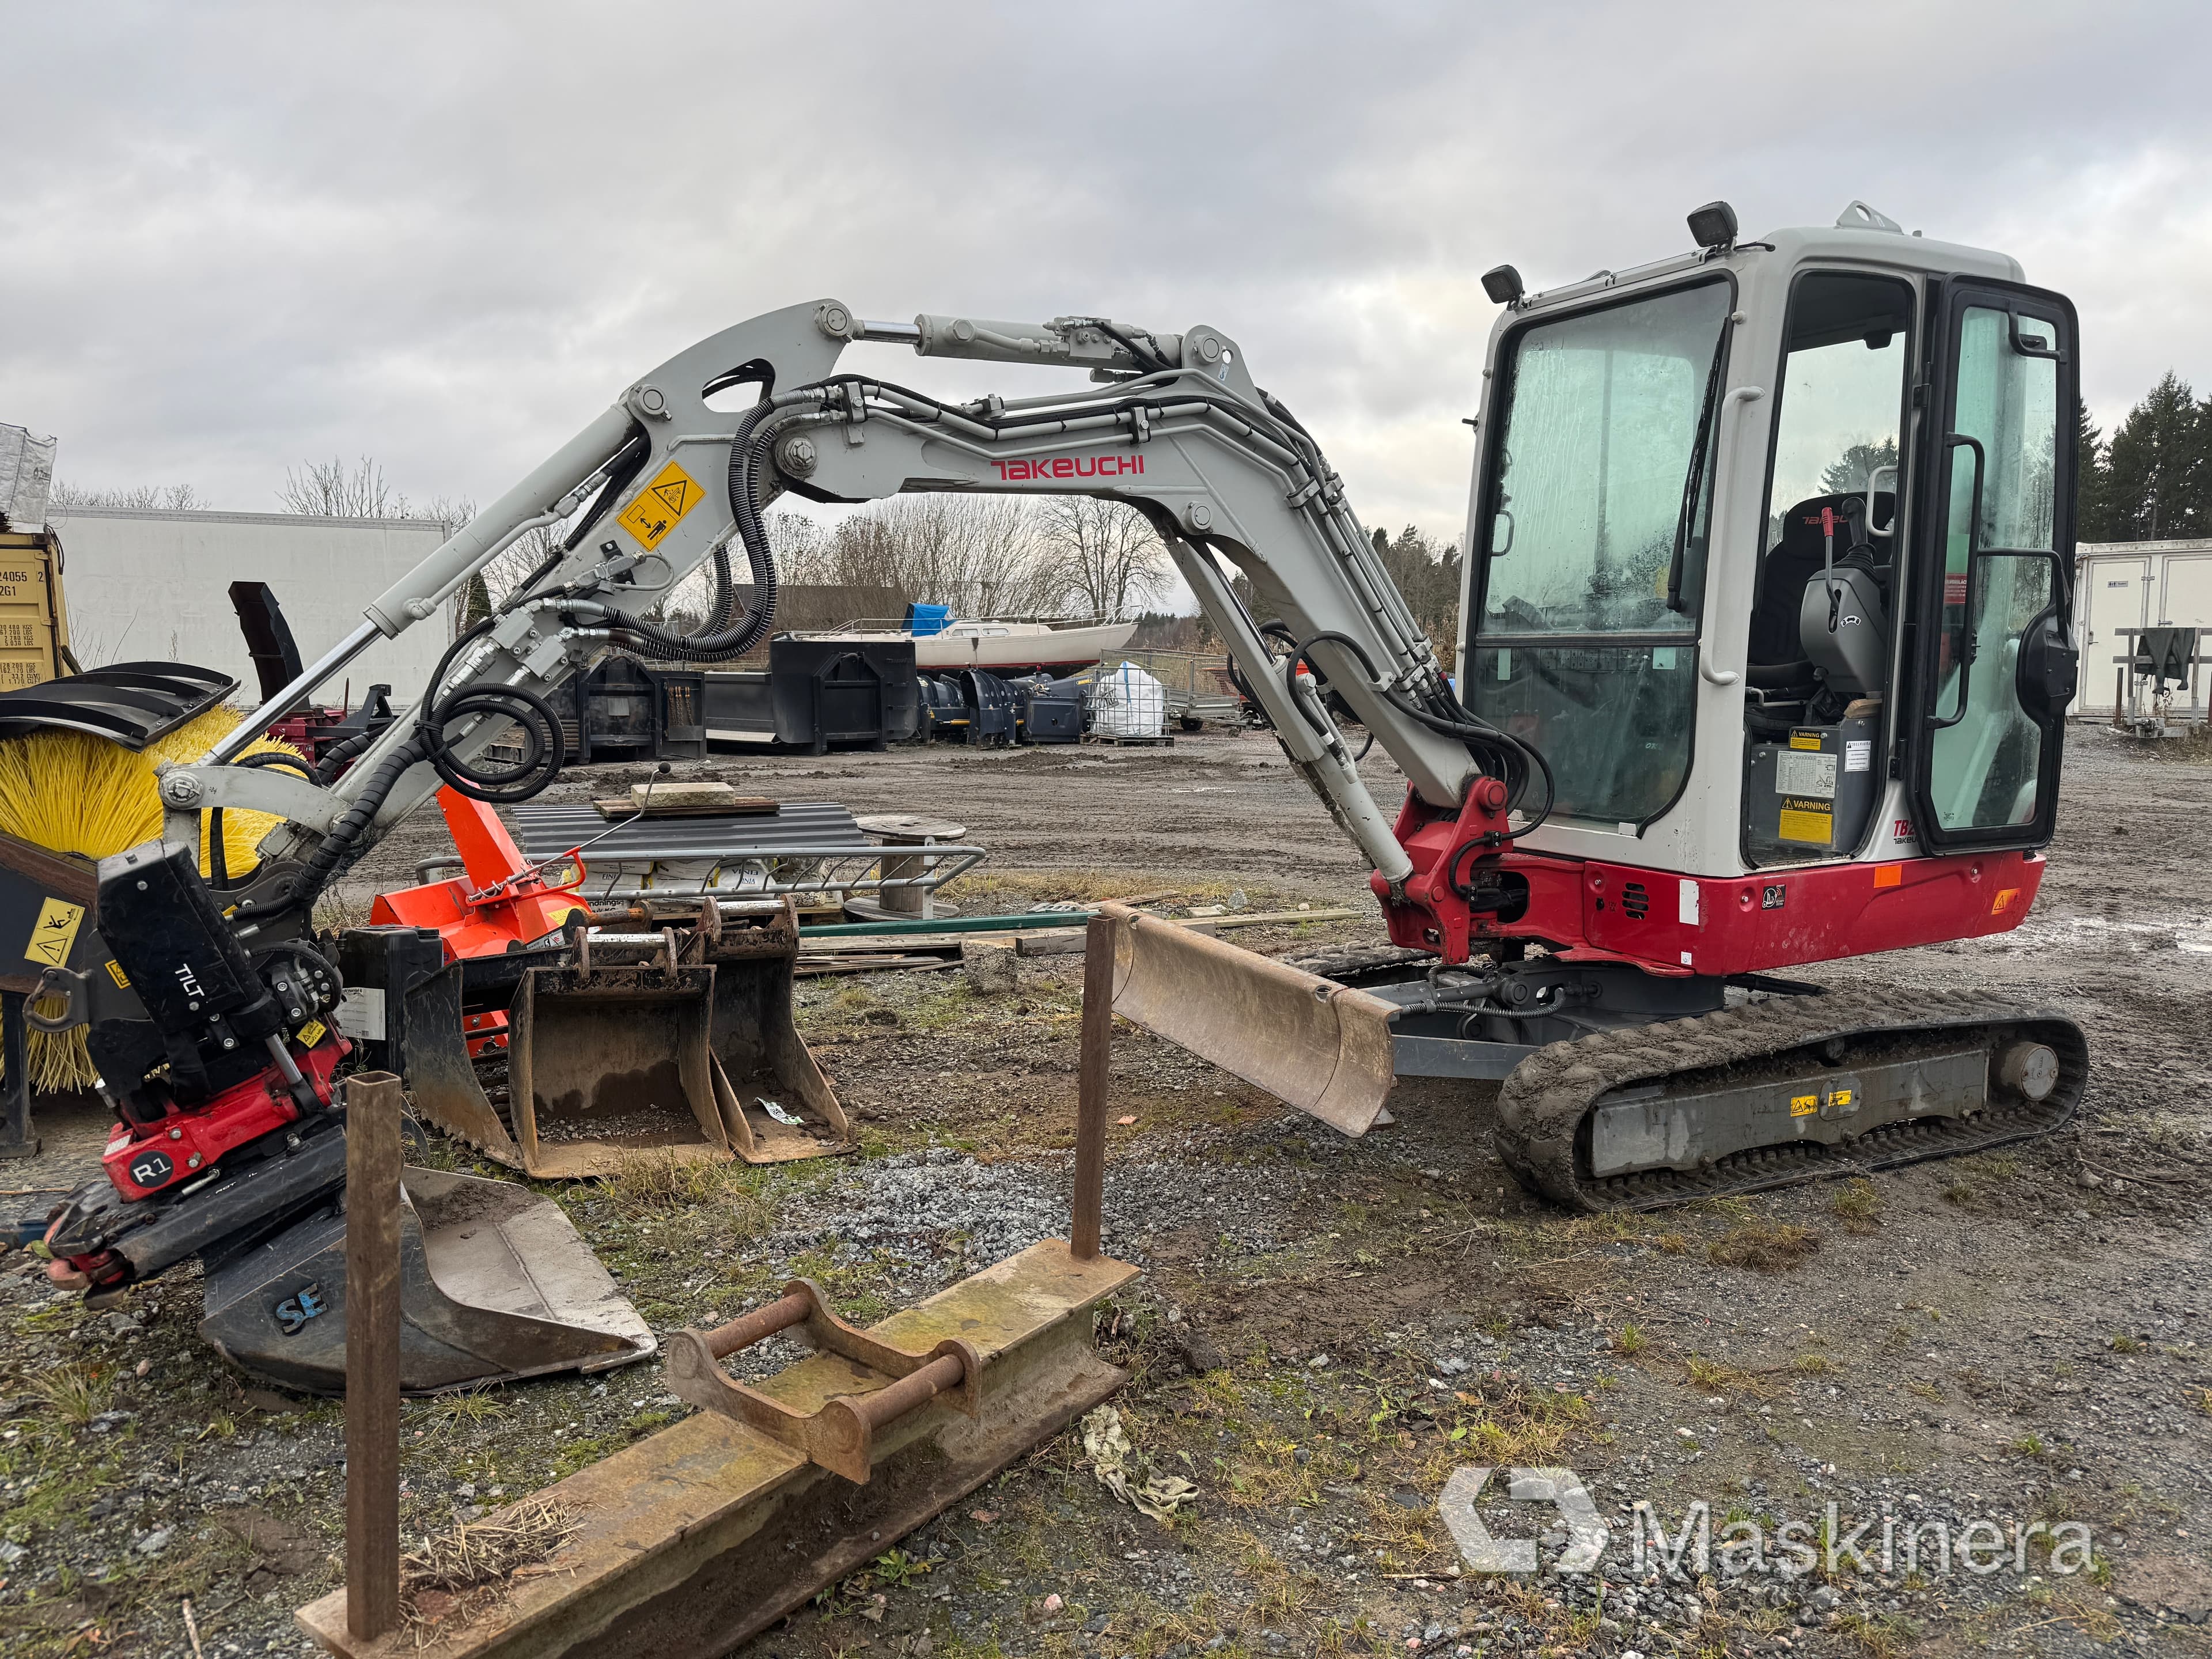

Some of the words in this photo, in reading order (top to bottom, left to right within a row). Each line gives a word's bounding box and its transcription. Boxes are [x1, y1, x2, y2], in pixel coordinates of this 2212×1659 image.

[38, 571, 44, 582] 2
[1793, 800, 1831, 811] VARNING
[1894, 820, 1917, 836] TB2
[1893, 836, 1917, 845] TAKEU
[175, 963, 205, 997] TILT
[133, 1157, 171, 1183] R1
